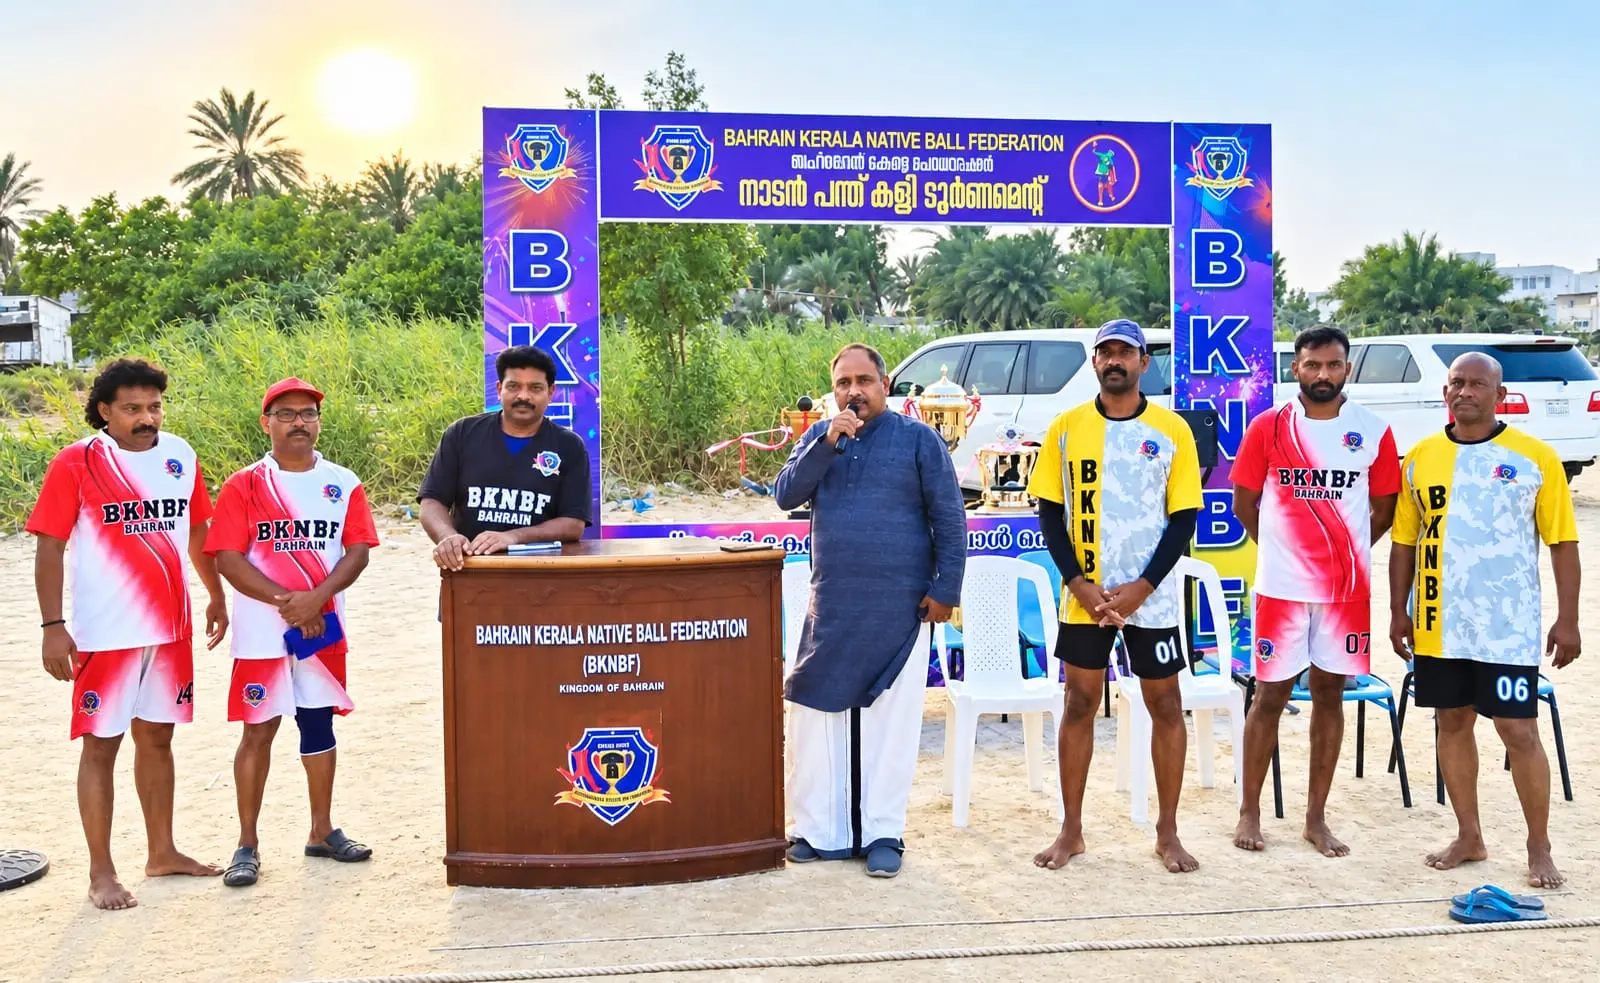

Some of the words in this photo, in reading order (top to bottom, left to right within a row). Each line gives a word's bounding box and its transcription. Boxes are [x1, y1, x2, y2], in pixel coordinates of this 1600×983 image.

[724, 128, 795, 147] BAHRAIN
[800, 130, 863, 148] KERALA
[866, 131, 921, 149] NATIVE
[925, 132, 965, 150] BALL
[968, 133, 1064, 151] FEDERATION
[739, 174, 808, 207] നാടൻ
[814, 173, 870, 208] പന്ത്
[871, 174, 917, 215] കളി
[1278, 468, 1361, 488] BKNBF
[467, 486, 551, 515] BKNBF
[1294, 487, 1343, 500] BAHRAIN
[102, 498, 188, 525] BKNBF
[477, 509, 532, 526] BAHRAIN
[1080, 459, 1098, 585] BKNB
[123, 519, 176, 536] BAHRAIN
[256, 519, 340, 543] BKNBF
[274, 539, 326, 553] BAHRAIN
[1424, 485, 1446, 632] BKNBF
[475, 624, 531, 646] BAHRAIN
[534, 624, 584, 645] KERALA
[587, 623, 633, 645] NATIVE
[636, 621, 668, 643] BALL
[670, 618, 748, 642] FEDERATION
[1345, 634, 1371, 655] 07
[1156, 637, 1178, 664] 01
[582, 652, 641, 678] (BKNBF)
[559, 684, 603, 694] KINGDOM
[607, 683, 620, 693] OF
[623, 681, 665, 692] BAHRAIN
[1496, 675, 1529, 702] 06
